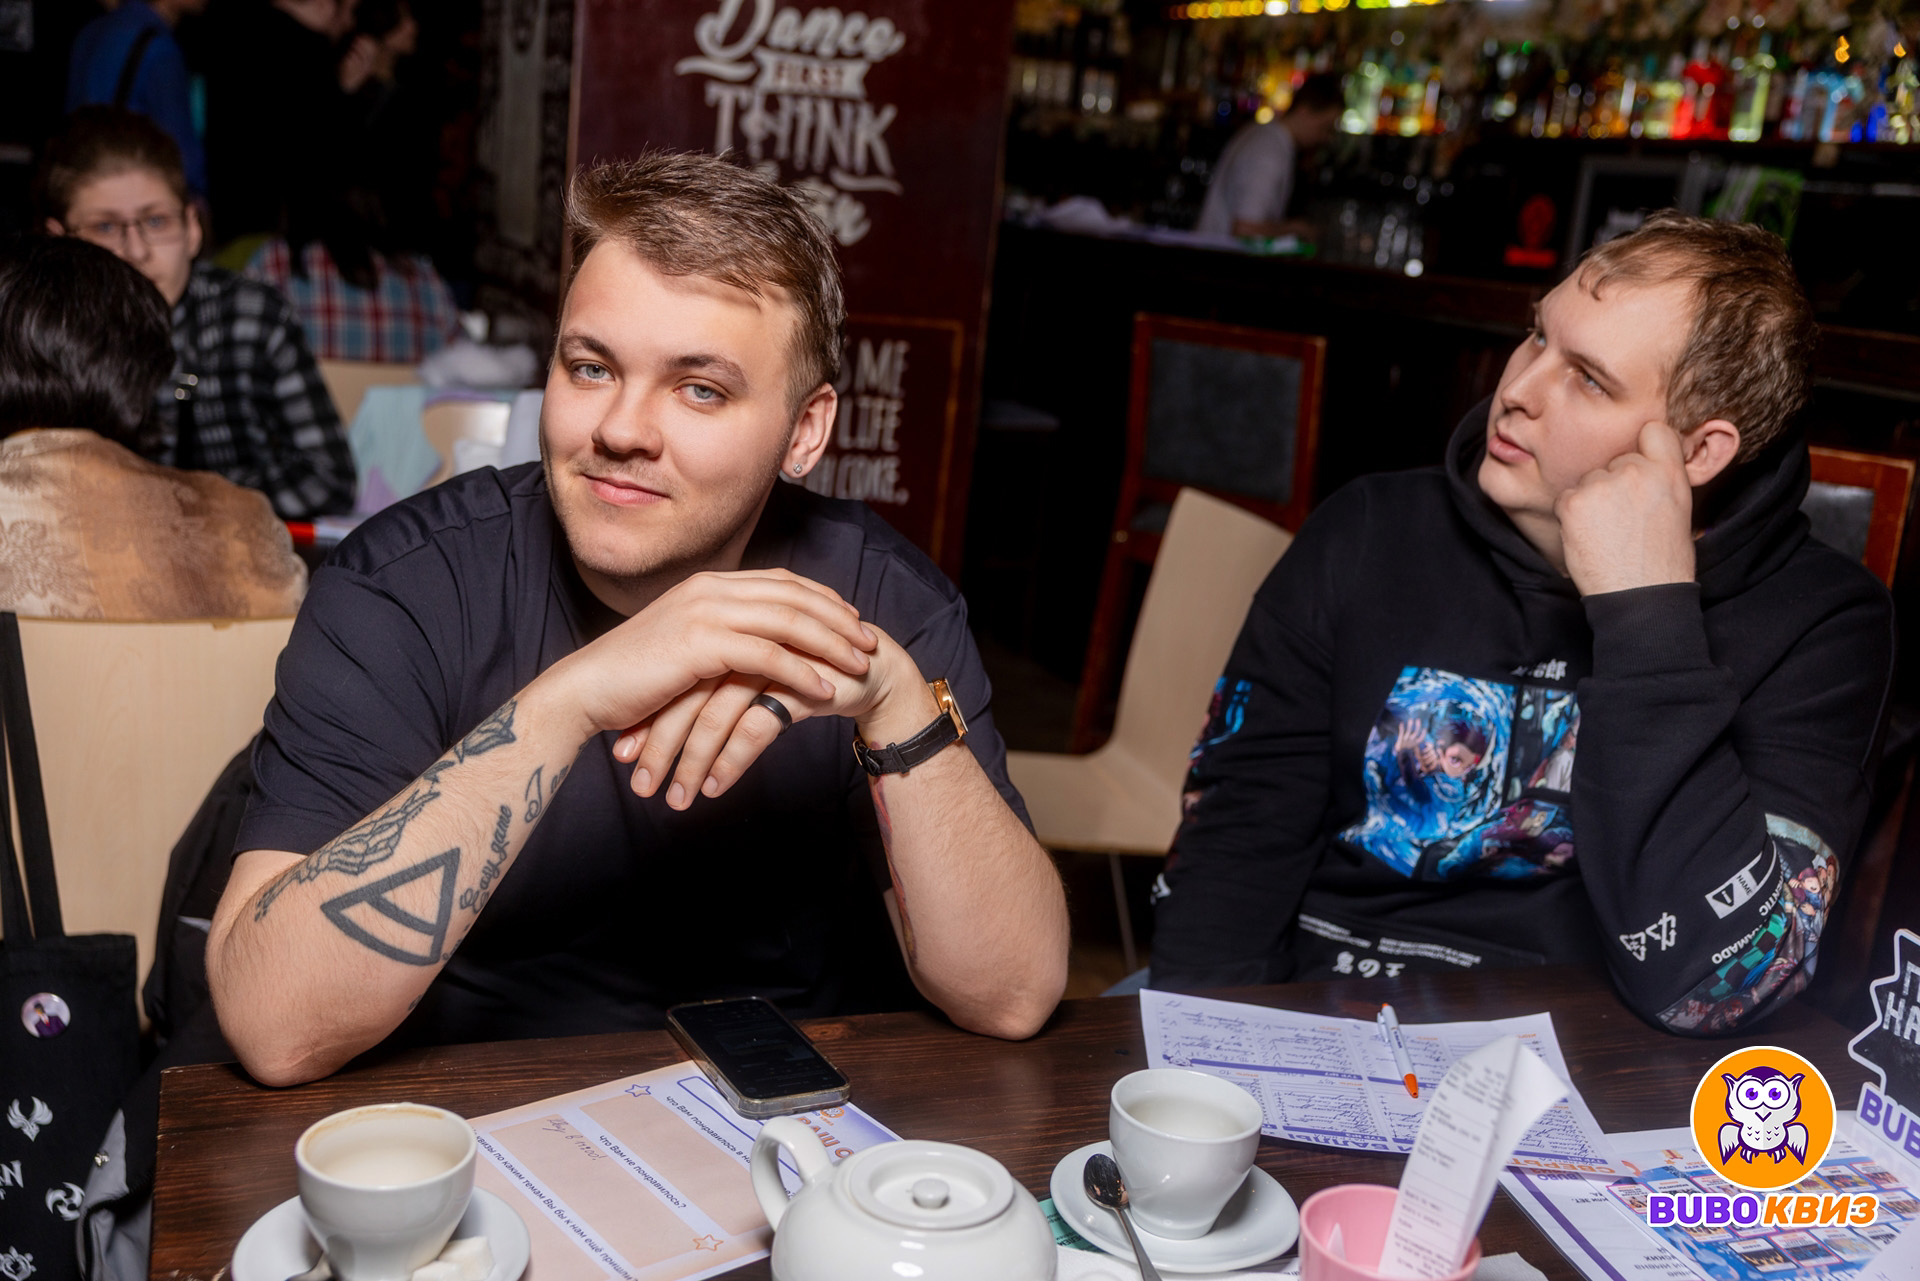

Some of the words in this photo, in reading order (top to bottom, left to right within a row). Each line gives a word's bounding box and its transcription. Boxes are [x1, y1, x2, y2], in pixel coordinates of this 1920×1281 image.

[694, 0, 906, 63] Dance
[704, 80, 899, 176] THINK
[1736, 874, 1754, 896] NAME
[676, 1103, 693, 1118] Вам
[691, 1115, 737, 1153] понравилось
[1287, 1133, 1390, 1150] БАЛЛЫ
[599, 1134, 611, 1148] Что
[609, 1142, 626, 1160] Вам
[623, 1156, 635, 1167] не
[633, 1163, 687, 1209] понравилось?
[1507, 1158, 1616, 1174] СВЕРЬТ
[493, 1152, 505, 1162] по
[502, 1159, 525, 1181] каким
[522, 1178, 546, 1200] темам
[543, 1198, 557, 1210] Вы
[554, 1208, 567, 1220] бы
[570, 1223, 588, 1239] нам
[584, 1237, 604, 1254] ещё
